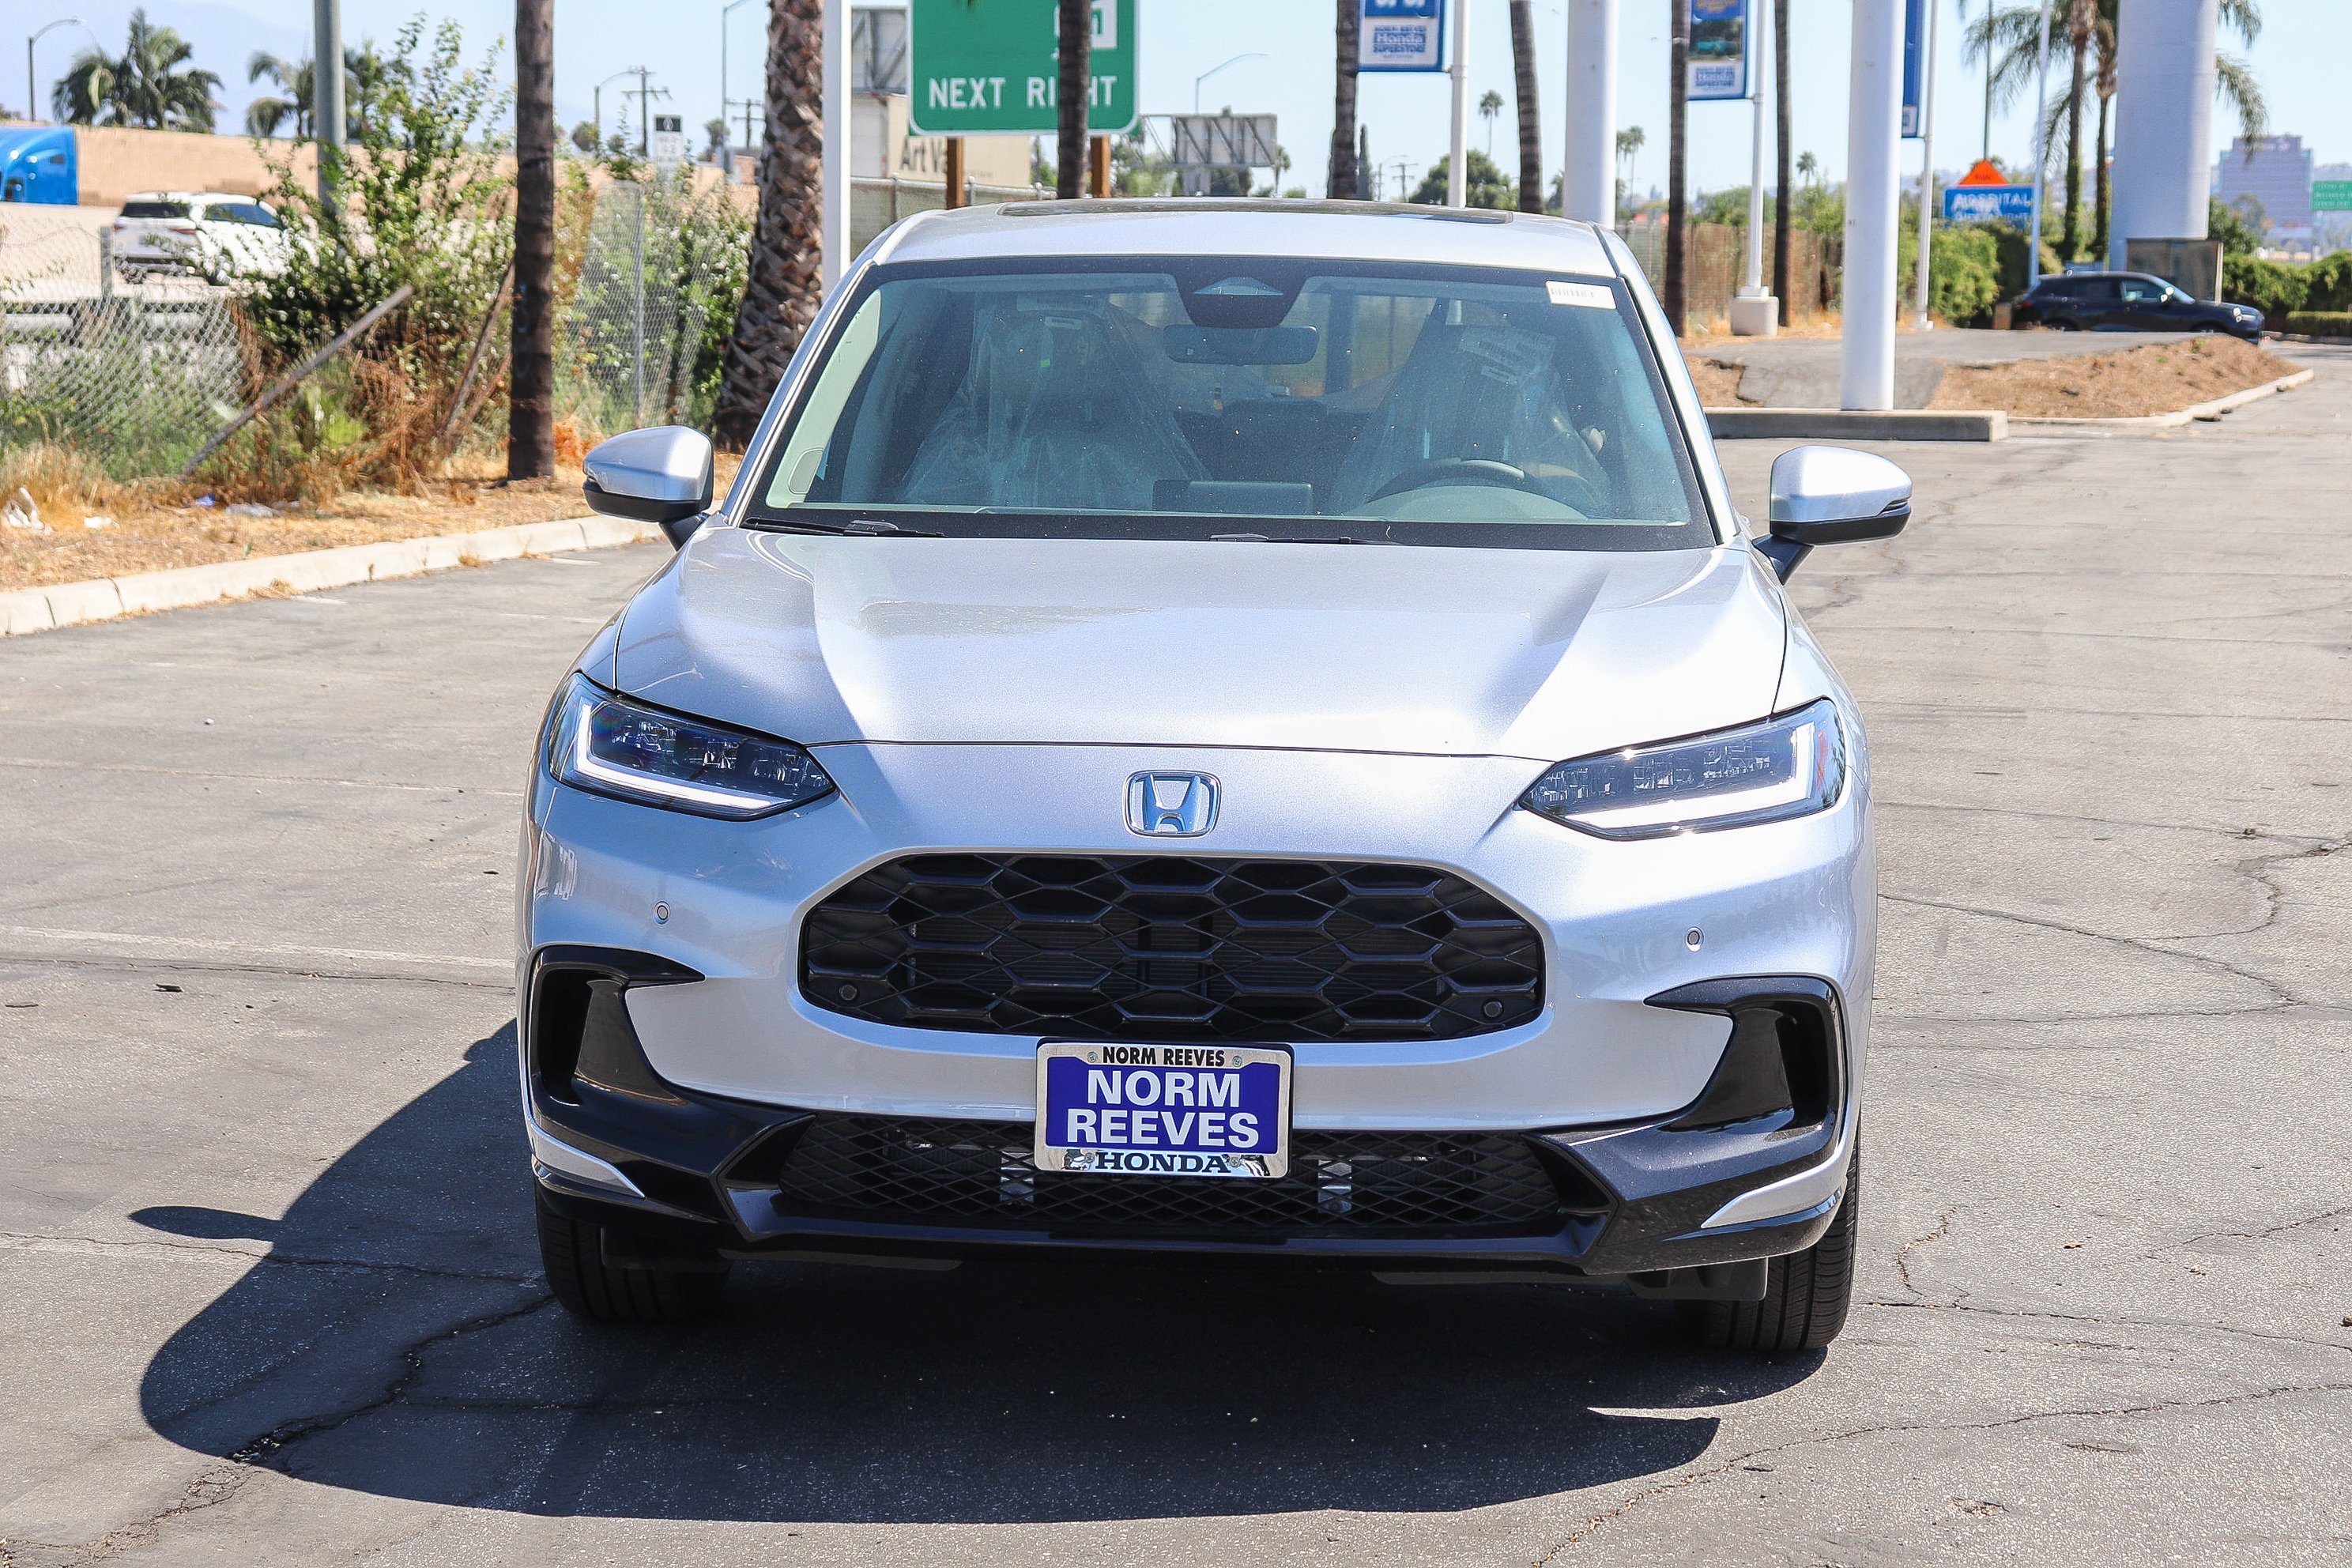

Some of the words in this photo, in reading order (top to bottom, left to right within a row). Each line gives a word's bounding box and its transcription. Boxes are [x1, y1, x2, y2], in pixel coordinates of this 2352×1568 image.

[929, 77, 1006, 108] NEXT
[1027, 76, 1118, 107] RIHT
[1102, 1046, 1157, 1066] NORM
[1163, 1048, 1225, 1067] REEVES
[1087, 1069, 1240, 1108] NORM
[1067, 1108, 1259, 1148] REEVES
[1095, 1152, 1231, 1174] HONDA
